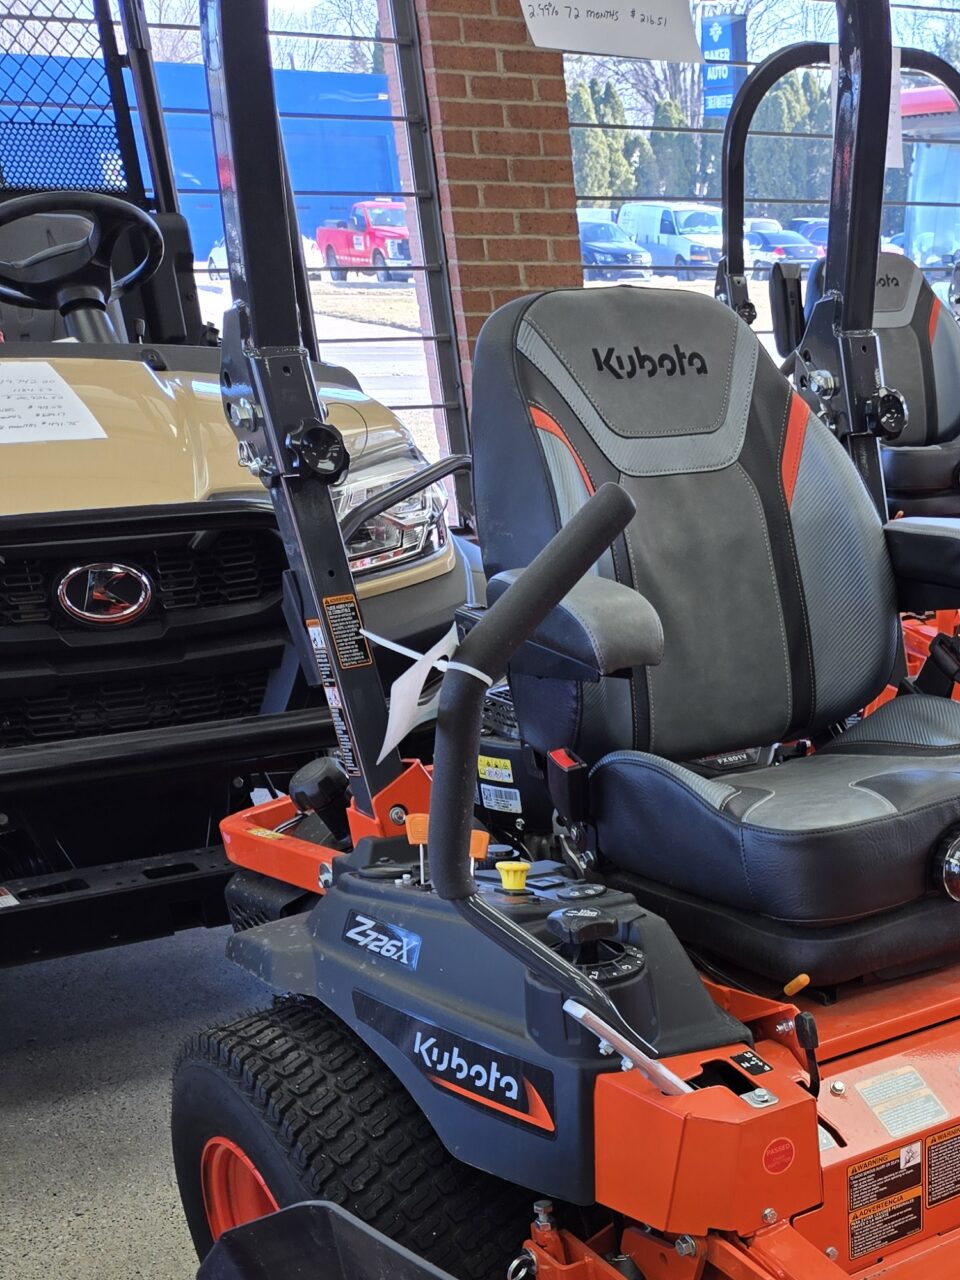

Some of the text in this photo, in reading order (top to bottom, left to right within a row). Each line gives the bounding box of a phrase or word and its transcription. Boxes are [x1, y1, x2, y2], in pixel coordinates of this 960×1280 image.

[564, 6, 580, 18] 72
[707, 64, 729, 80] AUTO
[876, 273, 900, 287] ota
[591, 343, 708, 380] Kubota
[346, 915, 420, 964] Z726X
[413, 1031, 519, 1100] Kubota
[766, 1142, 791, 1156] PASSED
[858, 1154, 887, 1171] WARNING
[859, 1194, 903, 1217] ADVERTENCIA
